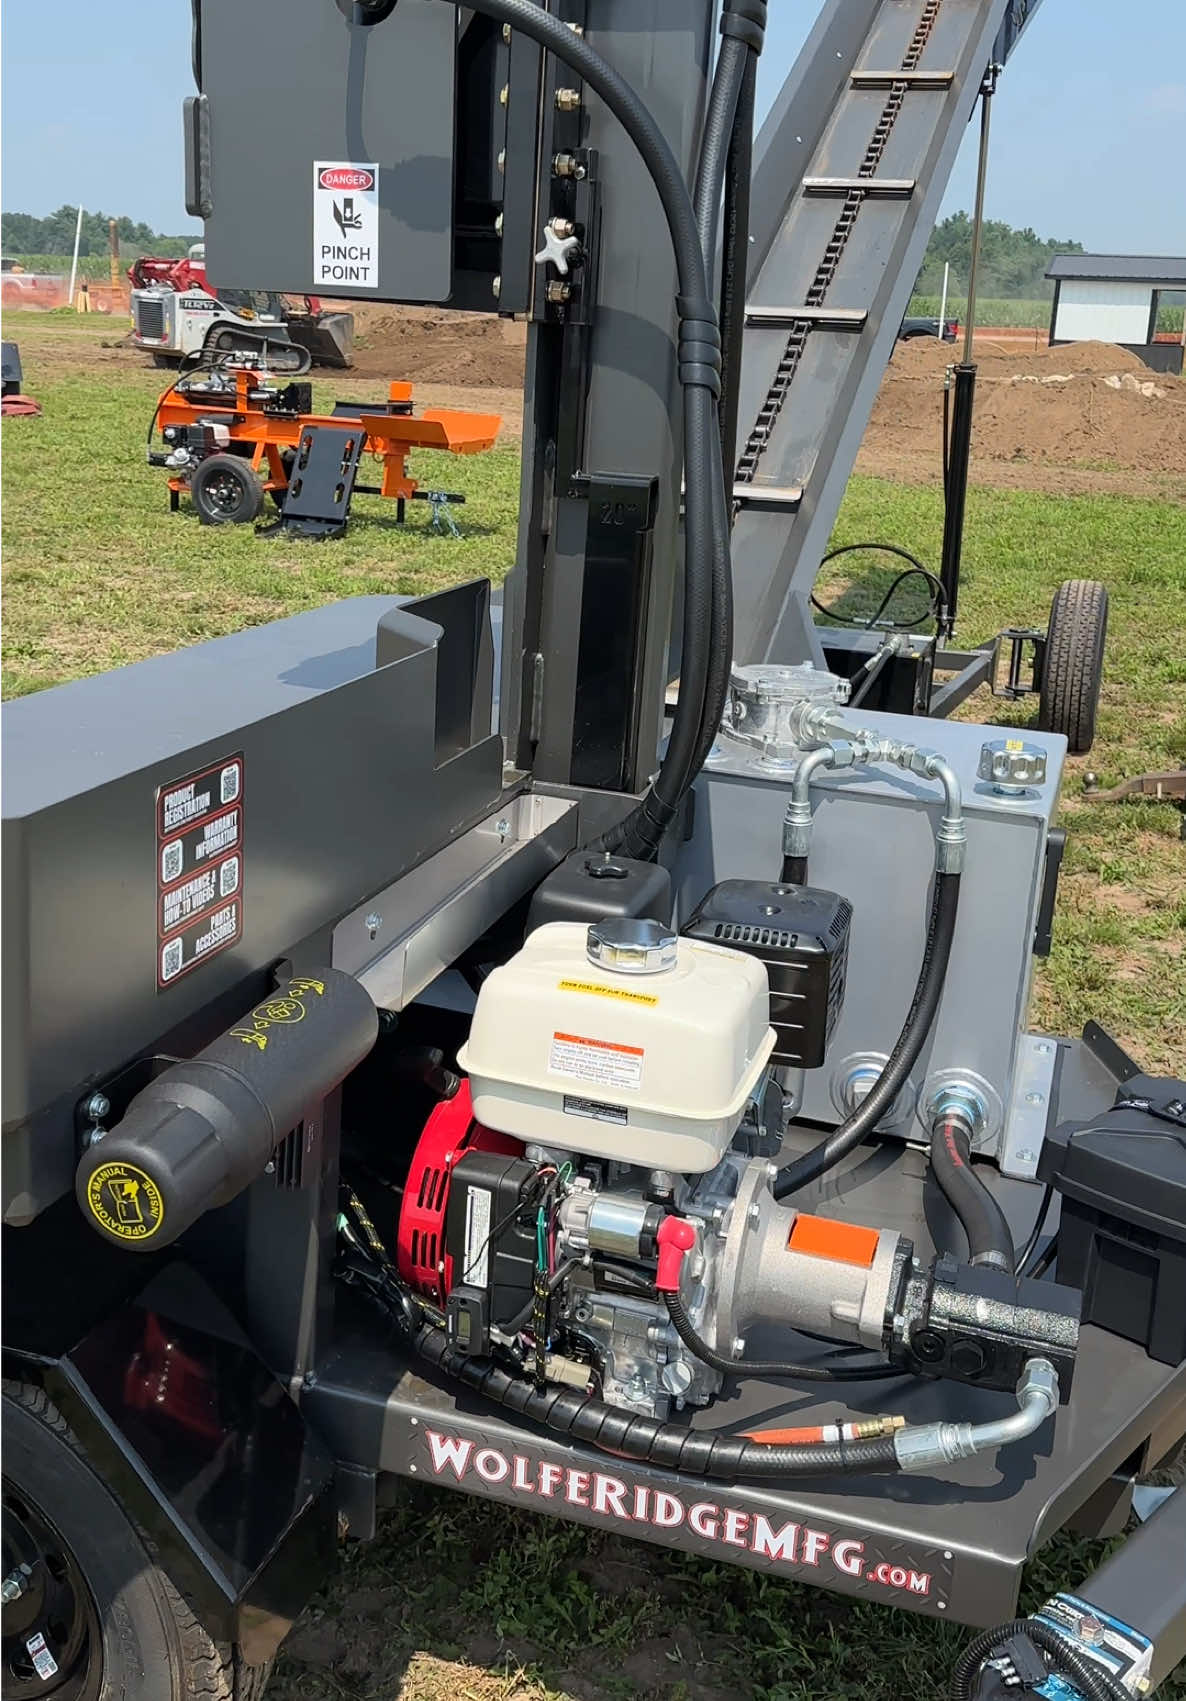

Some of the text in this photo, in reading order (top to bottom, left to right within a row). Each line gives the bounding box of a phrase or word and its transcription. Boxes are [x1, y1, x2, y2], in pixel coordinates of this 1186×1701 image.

[325, 174, 367, 186] DANGER
[321, 245, 370, 261] PINCH
[321, 265, 370, 281] POINT
[164, 783, 196, 812] PRODUCT
[164, 791, 211, 829] REGISTRATION
[203, 810, 238, 841] WARRANTY
[195, 825, 238, 860] INFORMATION
[164, 871, 211, 912] MAINTENANCE
[164, 897, 191, 927] HOW-TO
[191, 884, 215, 909] VIDEOS
[211, 906, 231, 931] PARTS
[195, 918, 237, 955] ACCESSORIES
[92, 1167, 160, 1236] OPERATOR'S MANUAL INSIDE
